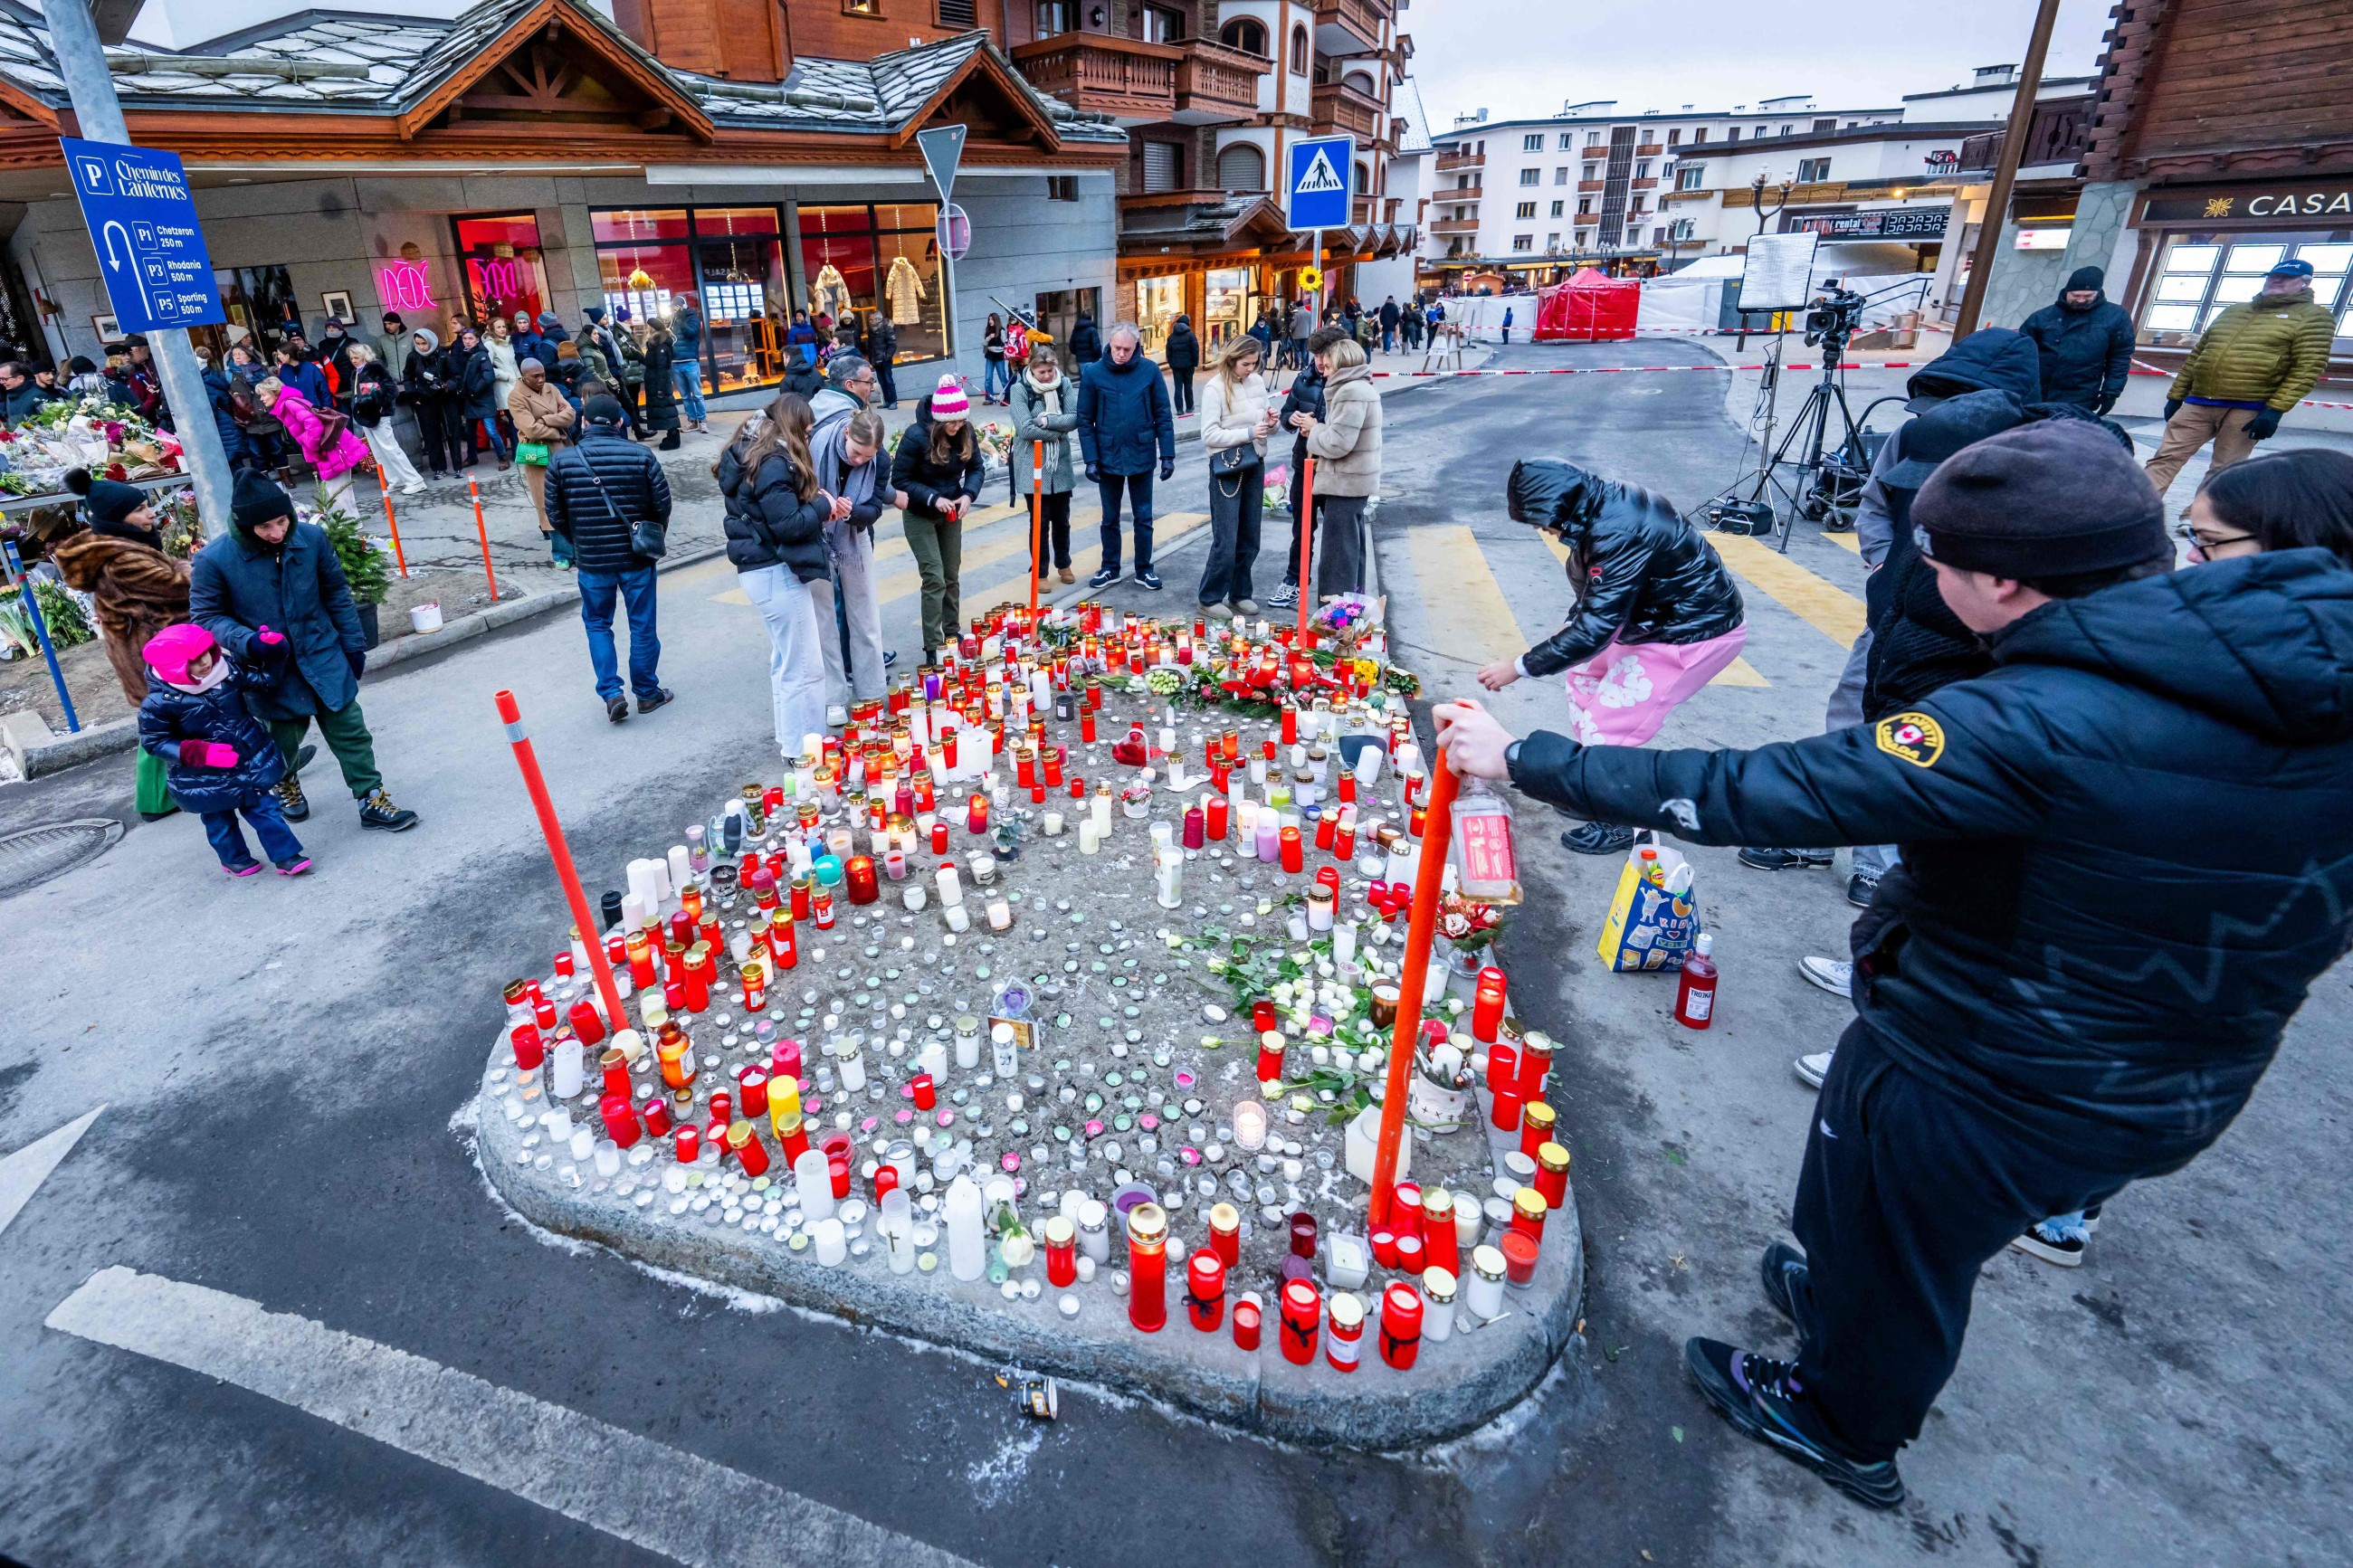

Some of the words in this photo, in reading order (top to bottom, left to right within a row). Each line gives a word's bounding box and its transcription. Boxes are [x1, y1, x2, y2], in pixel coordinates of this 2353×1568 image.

[85, 164, 102, 187] P
[115, 159, 163, 182] Chemin
[163, 168, 181, 184] des
[118, 178, 187, 201] Lanternes
[2248, 192, 2351, 216] CASA
[1834, 218, 1861, 228] rental
[138, 228, 152, 242] P1
[157, 225, 195, 236] Chetzeron
[160, 238, 175, 247] 250
[175, 240, 184, 248] m
[148, 264, 164, 277] P3
[167, 260, 202, 270] Rhodania
[171, 272, 186, 282] 500
[186, 273, 194, 281] m
[158, 298, 174, 310] P5
[176, 292, 208, 305] Sporting
[180, 305, 195, 315] 500
